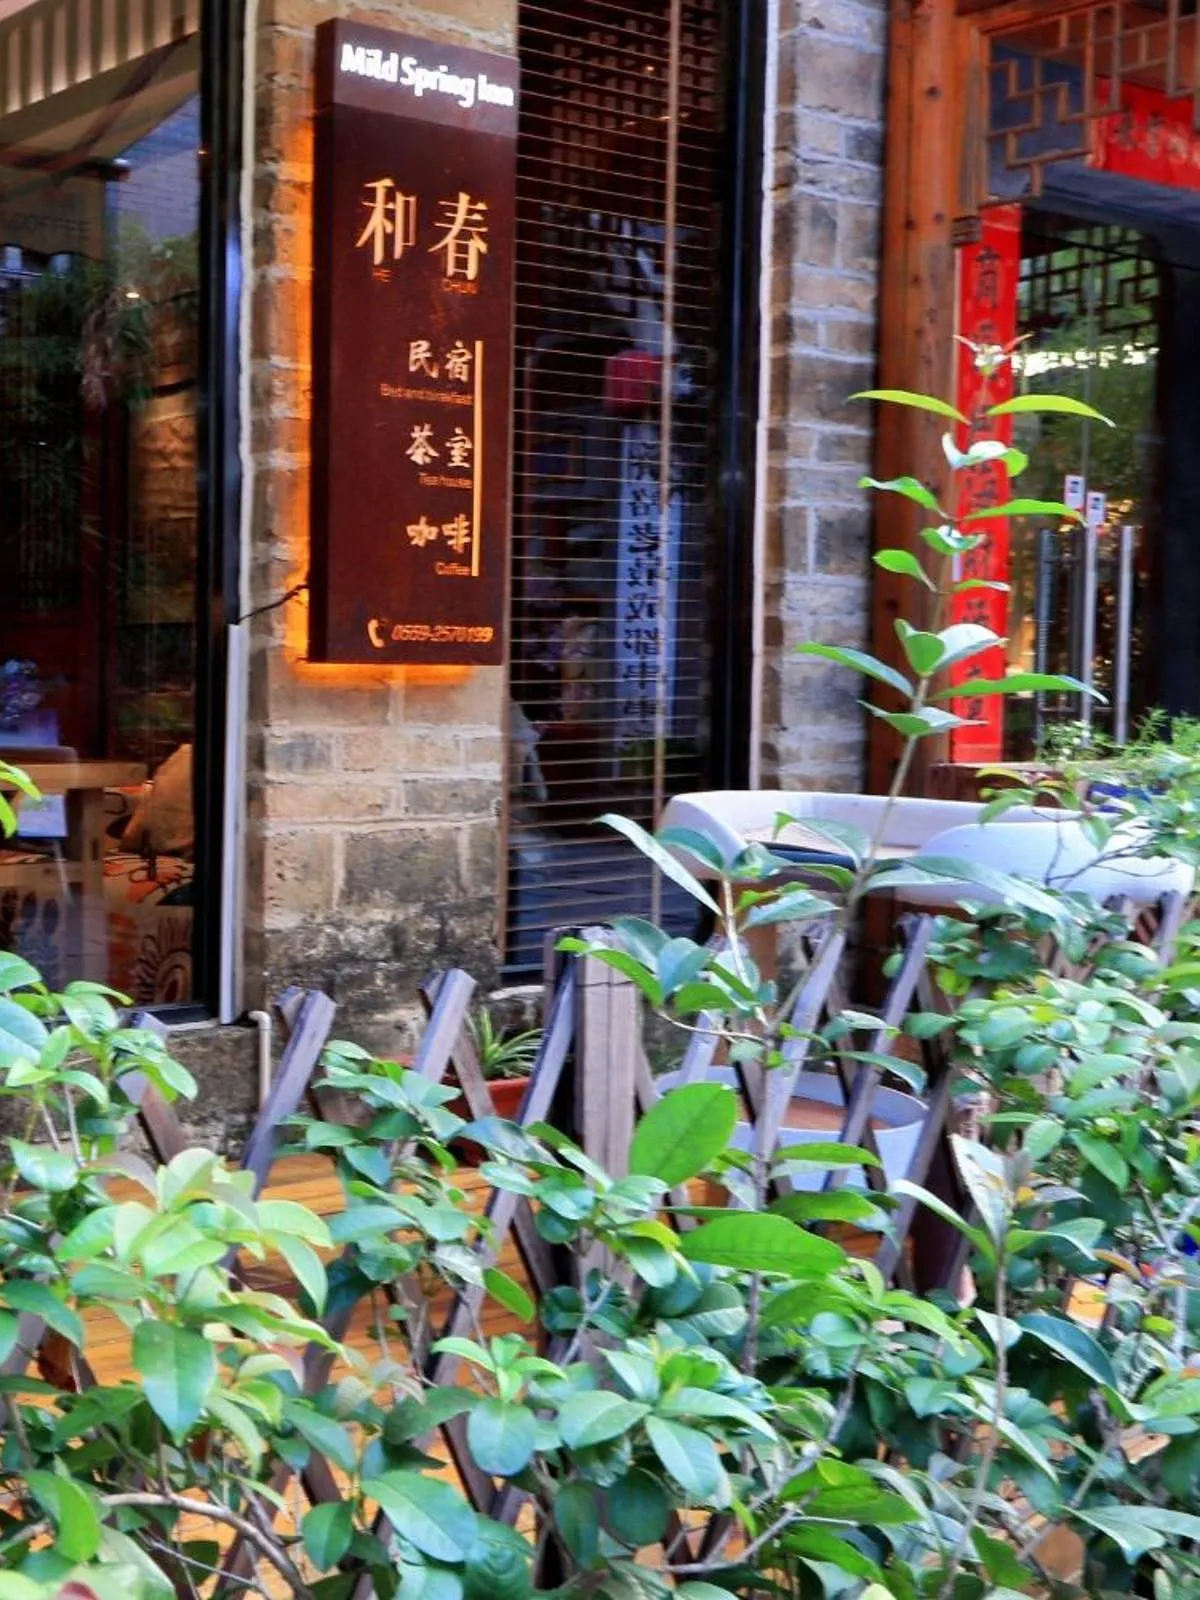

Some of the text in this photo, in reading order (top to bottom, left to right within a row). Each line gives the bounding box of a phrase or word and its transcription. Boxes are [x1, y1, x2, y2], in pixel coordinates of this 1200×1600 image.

[340, 44, 514, 107] Mild Spring Inn
[355, 178, 488, 280] 和春
[407, 340, 473, 382] 民宿
[406, 423, 473, 468] 茶室
[406, 514, 472, 554] 咖啡
